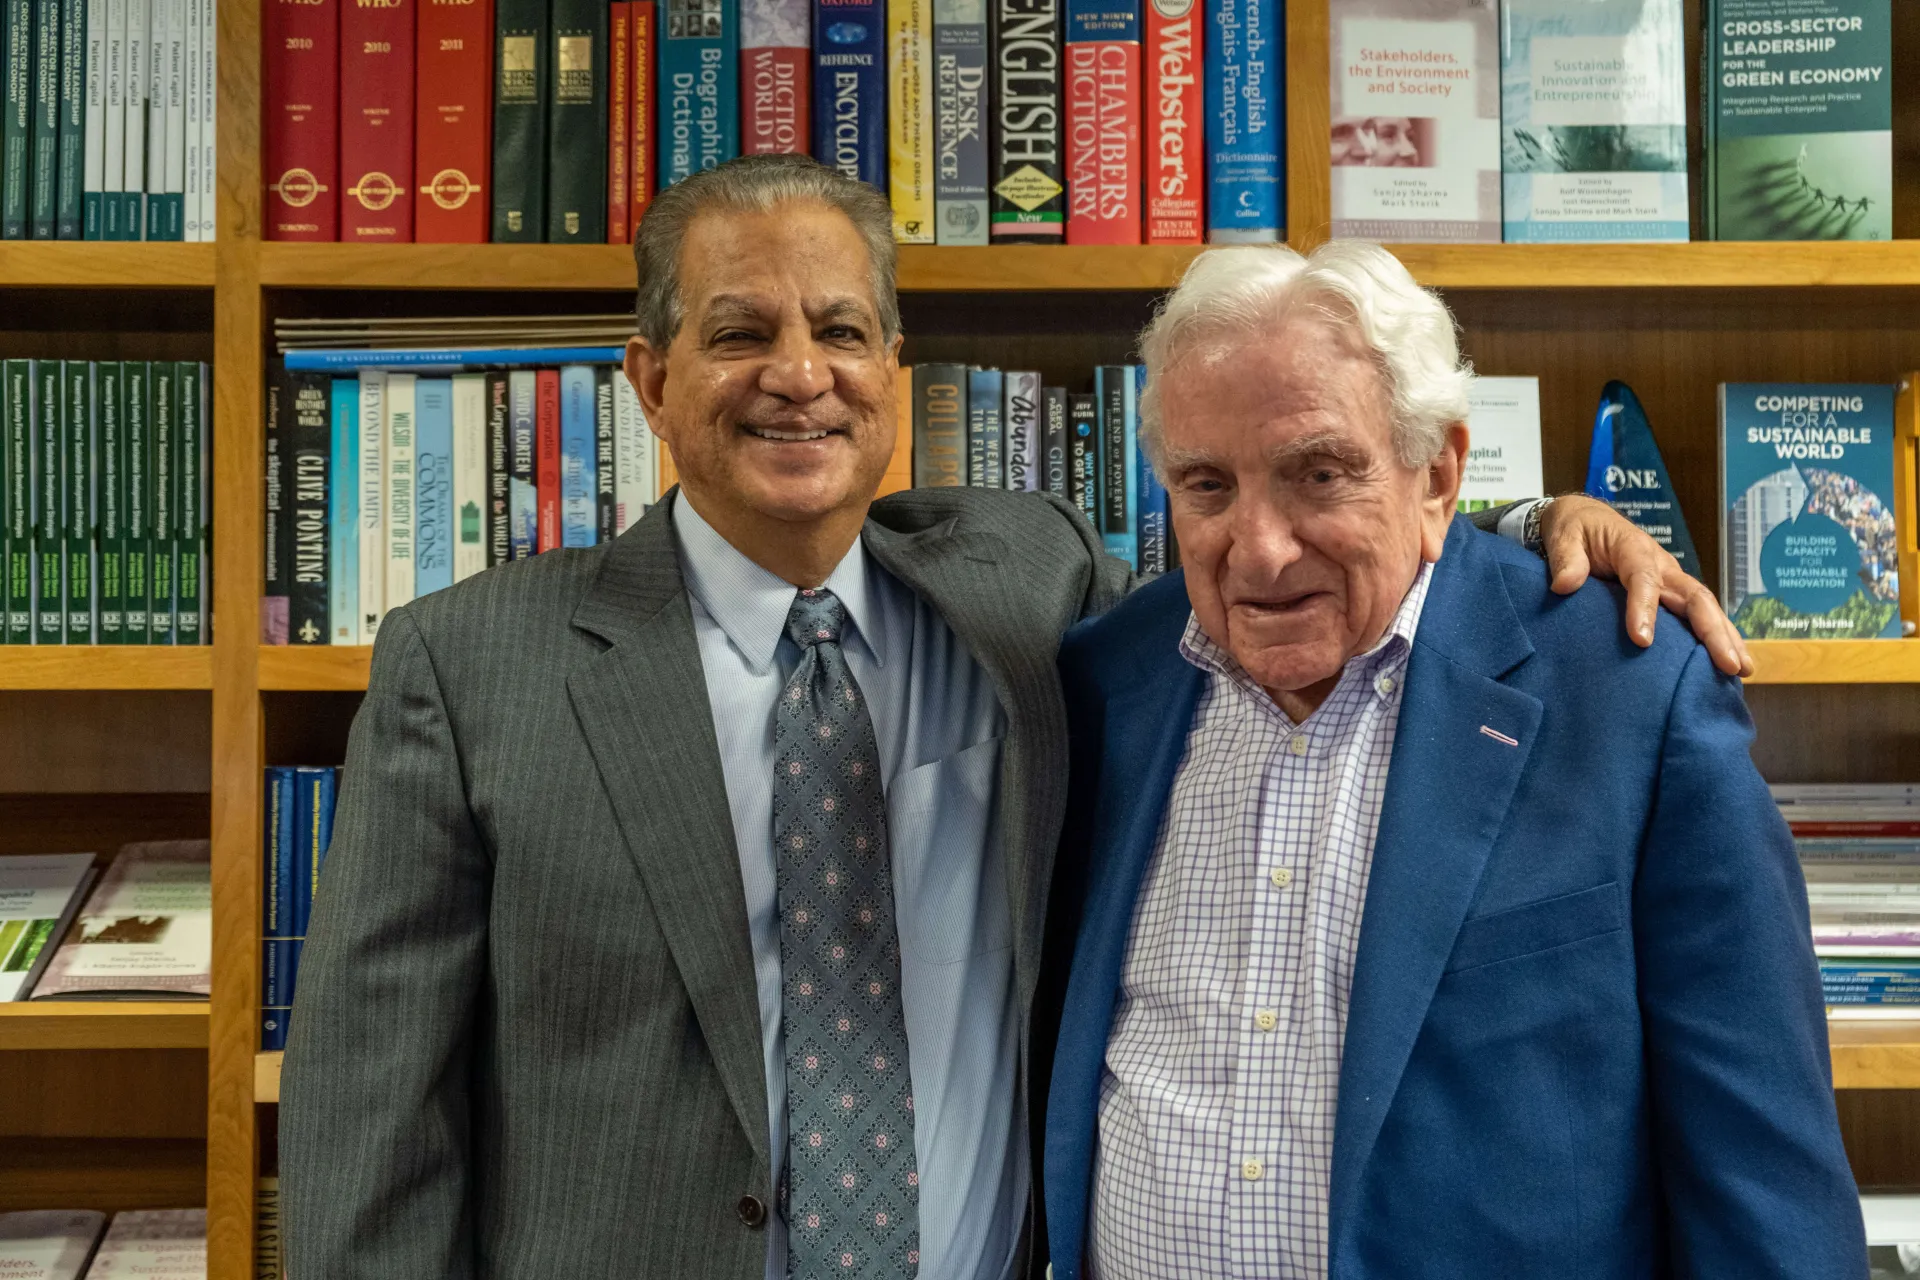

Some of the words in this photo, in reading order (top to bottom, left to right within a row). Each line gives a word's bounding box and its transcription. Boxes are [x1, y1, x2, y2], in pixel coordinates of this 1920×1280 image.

[20, 2, 28, 69] CROSS-SECTOR
[48, 3, 57, 69] CROSS-SECTOR
[64, 23, 72, 52] GREEN
[73, 0, 82, 67] CROSS-SECTOR
[616, 19, 625, 38] THE
[637, 16, 646, 36] THE
[1723, 16, 1862, 36] CROSS-SECTOR
[92, 40, 100, 72] Patient
[111, 40, 120, 71] Patient
[131, 40, 140, 72] Patient
[172, 41, 180, 72] Patient
[286, 38, 313, 49] 2010
[364, 42, 391, 53] 2010
[440, 40, 463, 50] 2011
[1360, 49, 1458, 63] Stakeholders,
[1723, 37, 1836, 55] LEADERSHIP
[154, 43, 163, 74] Patient
[616, 41, 625, 101] CANADIAN
[637, 39, 646, 100] CANADIAN
[820, 54, 873, 66] REFERENCE
[1349, 65, 1372, 77] the
[1377, 65, 1469, 79] Environment
[1723, 61, 1744, 70] FOR
[1747, 60, 1766, 69] THE
[10, 58, 18, 102] ECONOMY
[39, 58, 47, 103] ECONOMY
[90, 74, 99, 106] Capital
[110, 74, 119, 106] Capital
[129, 74, 139, 106] Capital
[170, 75, 180, 107] Capital
[1001, 0, 1056, 164] ENGLISH
[1368, 82, 1394, 93] and
[1400, 82, 1451, 97] Society
[1542, 76, 1616, 86] Innovation
[1723, 71, 1784, 87] GREEN
[1789, 67, 1882, 85] ECONOMY
[18, 72, 28, 128] LEADERSHIP
[47, 73, 56, 128] LEADERSHIP
[72, 70, 80, 125] LEADERSHIP
[152, 76, 162, 108] Capital
[754, 51, 773, 136] WORLD
[958, 66, 984, 142] DESK
[1723, 96, 1768, 106] Integrating
[1770, 95, 1807, 103] Research
[1810, 94, 1825, 102] and
[636, 103, 646, 140] WHO'S
[939, 54, 958, 180] REFERENCE
[1159, 20, 1195, 196] Webster's
[1736, 107, 1782, 115] Sustainable
[1785, 106, 1827, 114] Enterprise
[1072, 47, 1096, 221] DICTIONARY
[1100, 45, 1127, 220] CHAMBERS
[615, 146, 624, 173] WHO
[636, 145, 645, 173] WHO
[1216, 152, 1278, 163] Dictionnaire
[1152, 198, 1196, 208] Collegiate
[1152, 208, 1197, 217] Dictionary
[1017, 214, 1042, 222] New
[1152, 229, 1197, 237] EDITION
[544, 382, 554, 397] the
[1113, 389, 1121, 413] THE
[364, 382, 379, 442] BEYOND
[599, 384, 611, 438] WALKING
[1755, 396, 1863, 412] COMPETING
[298, 416, 324, 426] WORLD
[392, 413, 411, 447] WILSON
[543, 400, 556, 459] Corporation
[620, 383, 630, 484] MANDELBAUM
[972, 409, 983, 432] TIM
[986, 409, 998, 432] THE
[1113, 419, 1121, 444] END
[1781, 413, 1819, 427] FOR
[1824, 413, 1837, 426] A
[490, 404, 508, 470] Corporations
[1075, 441, 1084, 455] TO
[1747, 428, 1871, 444] SUSTAINABLE
[364, 446, 379, 476] THE
[437, 454, 449, 476] THE
[515, 430, 530, 472] KORTEN
[599, 440, 612, 462] THE
[1085, 452, 1093, 476] WHY
[1775, 444, 1844, 459] WORLD
[296, 455, 324, 500] CLIVE
[393, 460, 410, 474] THE
[599, 465, 612, 494] TALK
[1075, 459, 1085, 479] GET
[266, 455, 281, 510] skeptical
[493, 473, 508, 497] Rule
[1076, 482, 1084, 490] A
[1085, 479, 1094, 509] YOUR
[1114, 464, 1122, 519] POVERTY
[364, 481, 379, 528] LIMITS
[392, 479, 410, 524] DIVERSITY
[419, 453, 436, 570] COMMONS
[437, 481, 449, 524] DRAMA
[295, 509, 324, 582] PONTING
[393, 529, 410, 538] OF
[494, 515, 508, 556] WORLD
[1144, 512, 1156, 572] YUNUS
[1156, 512, 1164, 572] MUHAMMAD
[1786, 537, 1836, 546] BUILDING
[392, 542, 410, 559] LIFE
[438, 548, 447, 567] THE
[1785, 548, 1837, 556] CAPACITY
[1801, 557, 1822, 566] FOR
[1776, 568, 1848, 577] SUSTAINABLE
[1779, 579, 1845, 588] INNOVATION
[1774, 617, 1810, 631] Sanjay
[1812, 617, 1854, 629] Sharma
